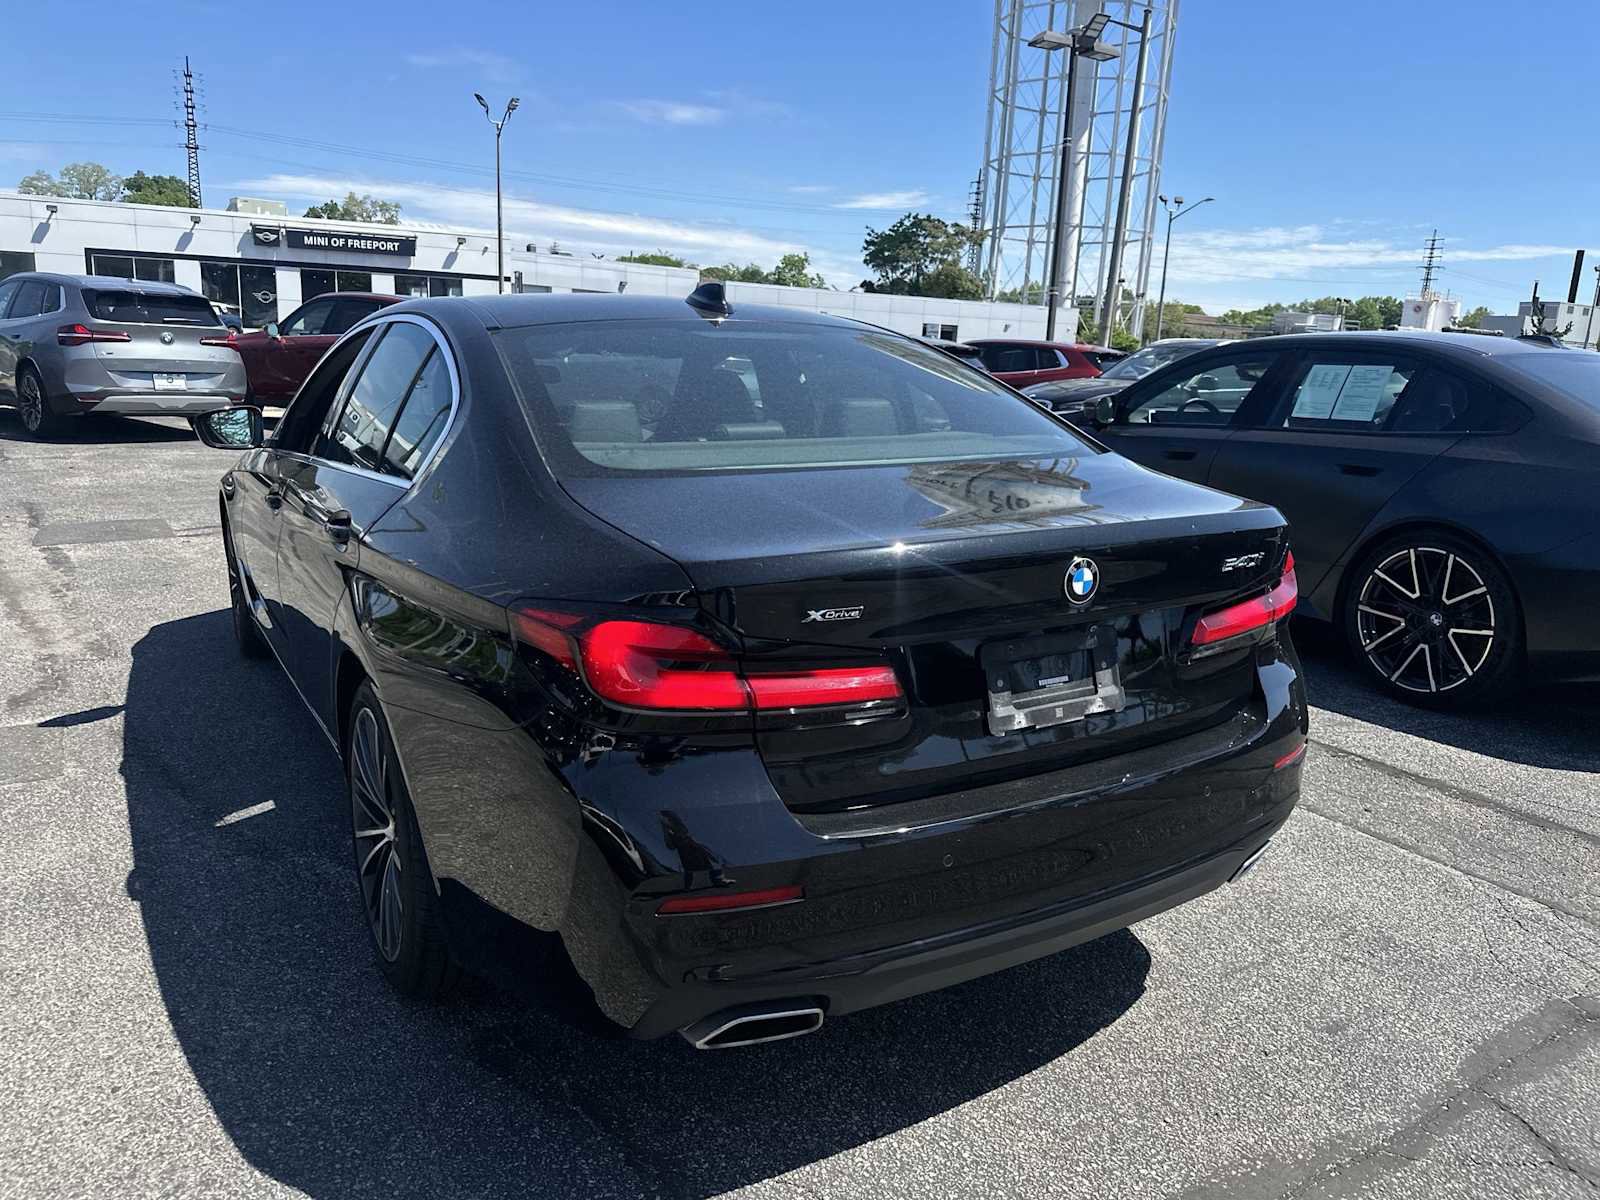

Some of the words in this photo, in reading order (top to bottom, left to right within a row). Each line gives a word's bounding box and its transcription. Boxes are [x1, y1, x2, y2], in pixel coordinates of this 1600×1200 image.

[303, 235, 329, 247] MINI
[331, 238, 346, 248] OF
[347, 239, 400, 252] FREEPORT
